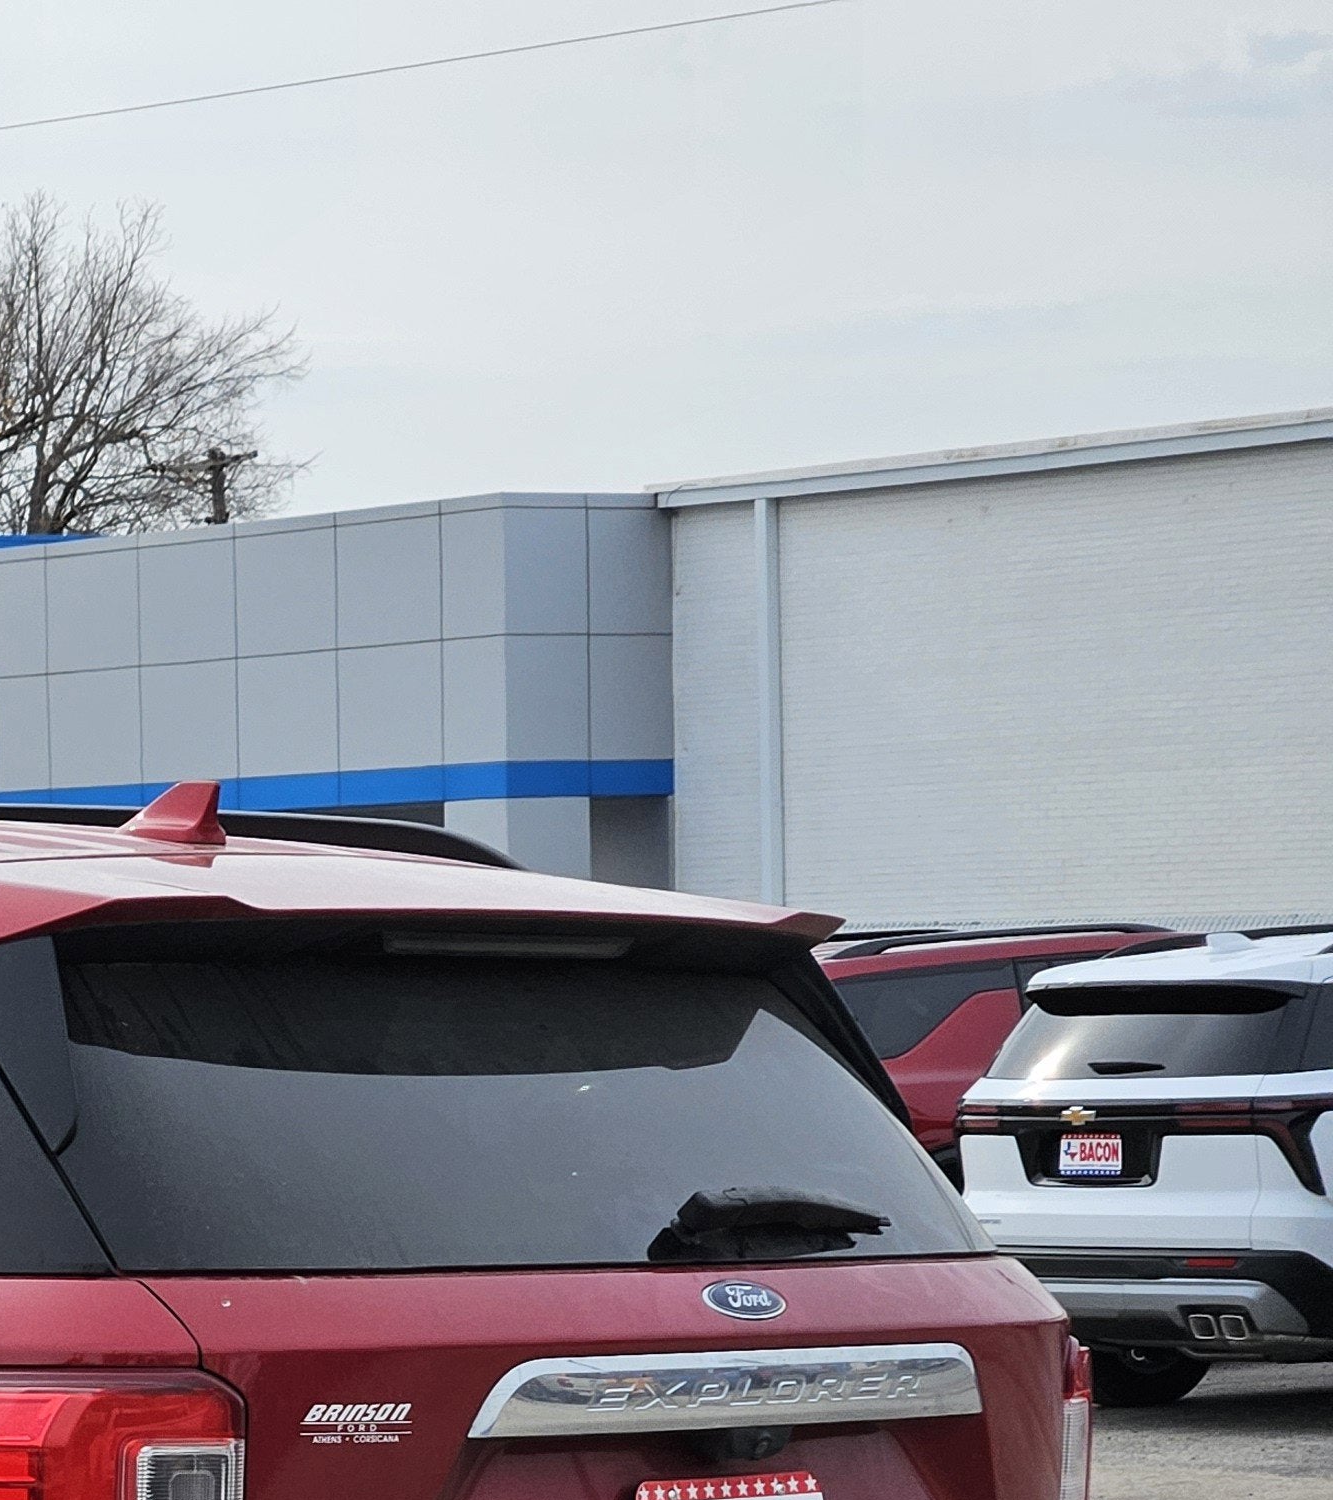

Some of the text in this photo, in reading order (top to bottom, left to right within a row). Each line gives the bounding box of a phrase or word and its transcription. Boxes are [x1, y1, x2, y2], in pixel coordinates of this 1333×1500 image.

[1079, 1141, 1120, 1163] BACON
[725, 1284, 773, 1309] Ford
[585, 1373, 923, 1412] EXPLORER
[303, 1403, 412, 1421] BRINSON
[336, 1423, 378, 1432] FORD
[311, 1434, 400, 1444] ATHENS CORSICANA
